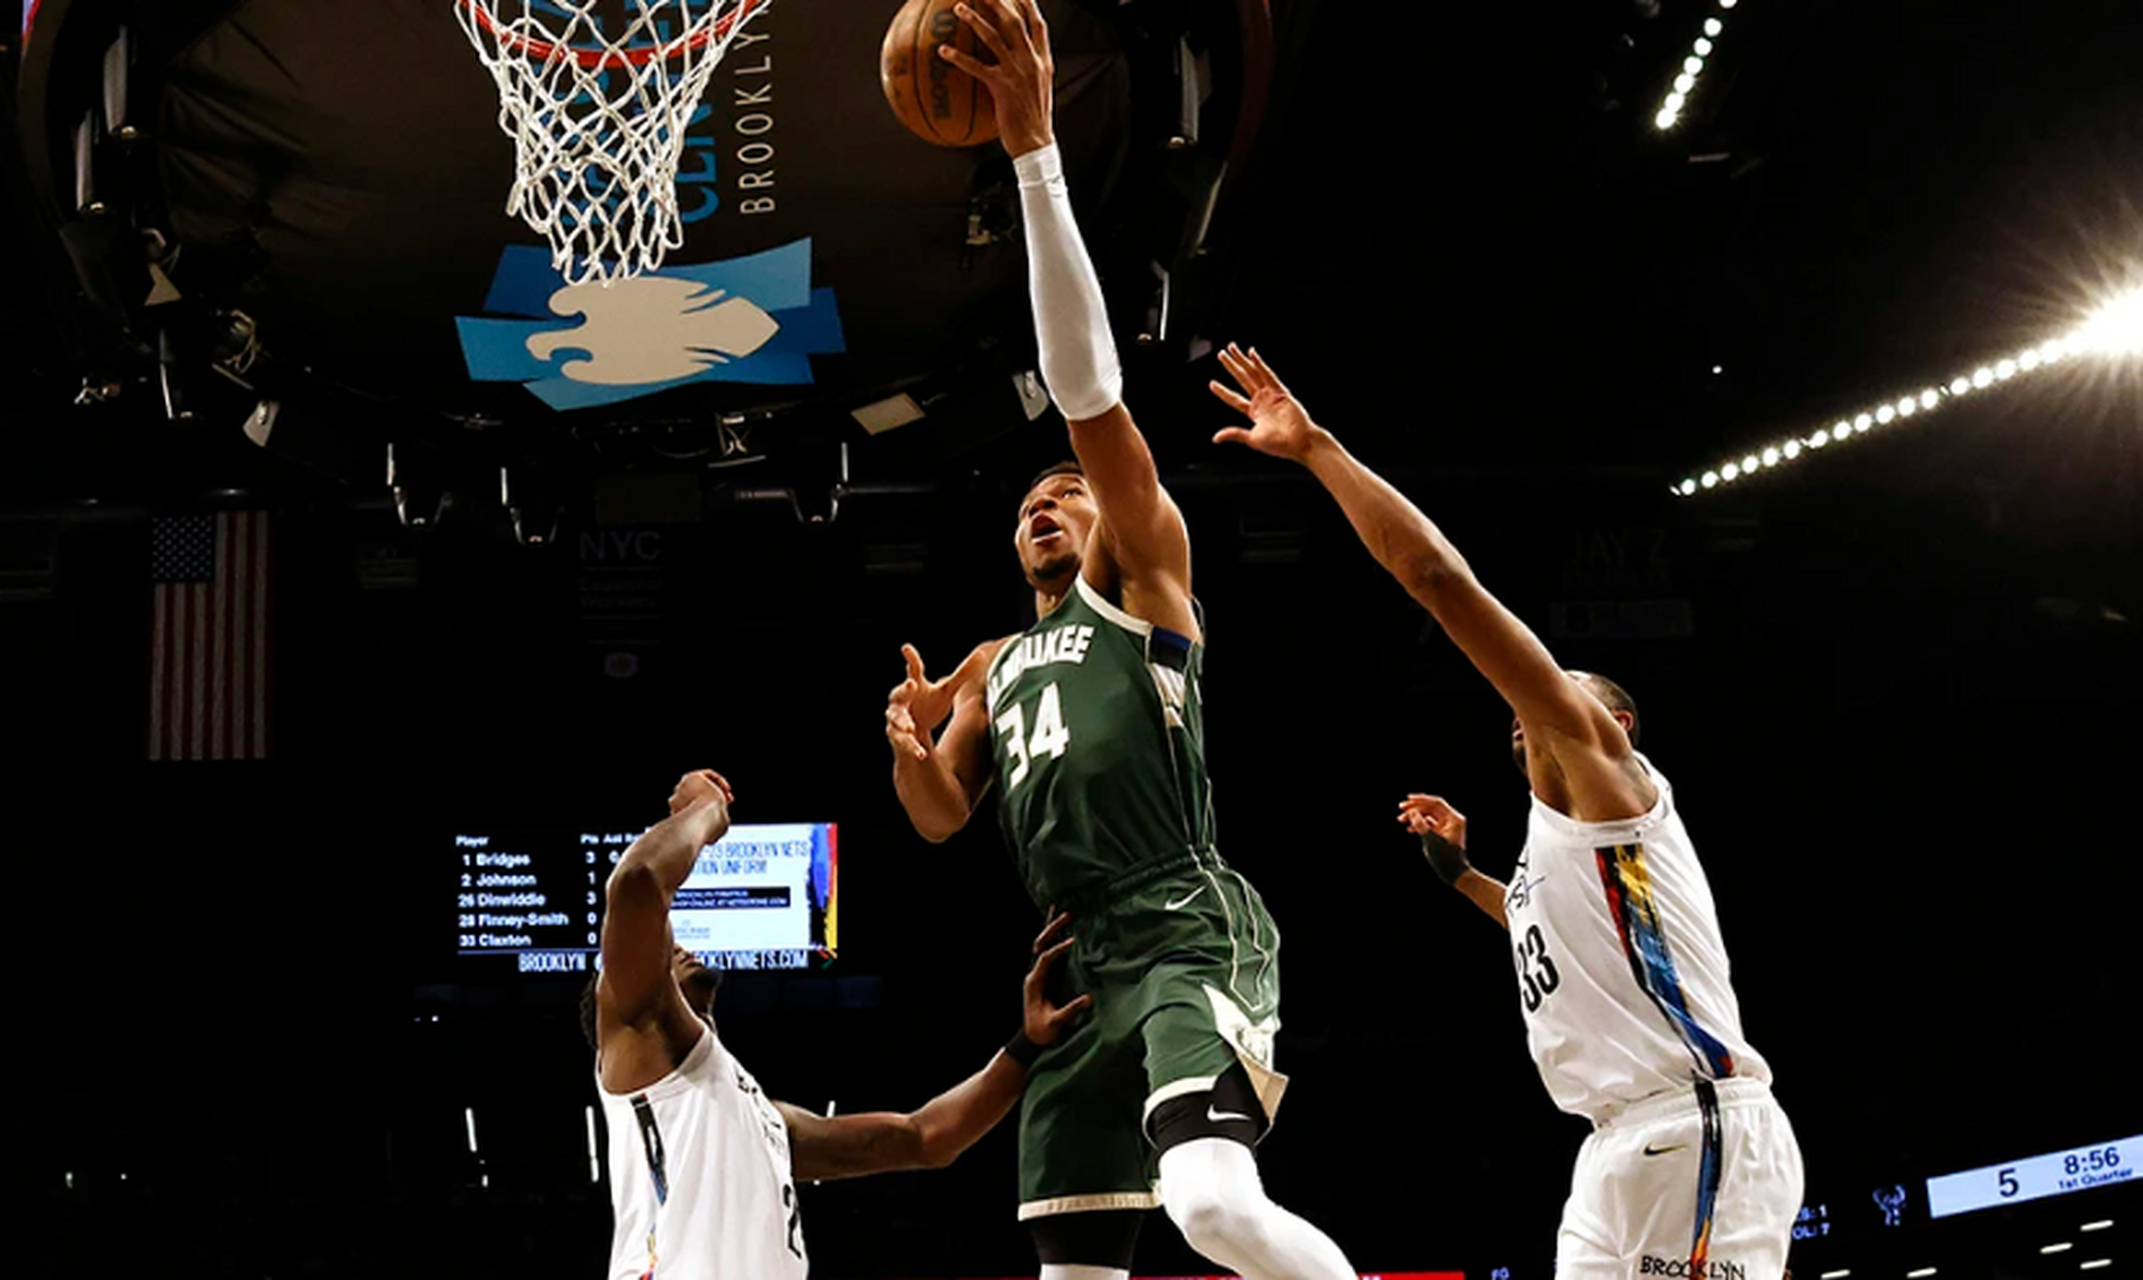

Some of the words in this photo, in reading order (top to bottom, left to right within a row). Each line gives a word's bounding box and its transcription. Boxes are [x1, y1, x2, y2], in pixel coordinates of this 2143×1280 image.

[734, 6, 776, 214] BROOKLY
[578, 529, 662, 562] NYC
[996, 681, 1070, 790] 34
[455, 835, 489, 848] Player
[725, 840, 779, 858] BROOKLYN
[780, 840, 810, 857] NETS
[462, 854, 470, 866] 1
[476, 852, 531, 869] Bridges
[585, 850, 595, 864] 3
[721, 858, 768, 875] UNIFORM
[461, 873, 472, 887] 2
[476, 873, 537, 887] Johnson
[588, 871, 596, 885] 1
[458, 892, 476, 907] 26
[477, 891, 546, 907] Dinwiddie
[586, 891, 597, 905] 3
[478, 912, 570, 930] Finney-Smith
[587, 911, 598, 925] 0
[459, 934, 476, 947] 33
[479, 933, 532, 947] Claxton
[587, 932, 598, 945] 0
[518, 953, 587, 972] BROOKLYN
[1516, 924, 1560, 1013] 33
[2064, 1146, 2120, 1176] 8:56
[1998, 1167, 2019, 1198] 5
[2058, 1178, 2079, 1190] 1st
[2081, 1168, 2133, 1185] Quarter
[1820, 1222, 1830, 1236] 7
[1639, 1255, 1745, 1280] BROOKLYN
